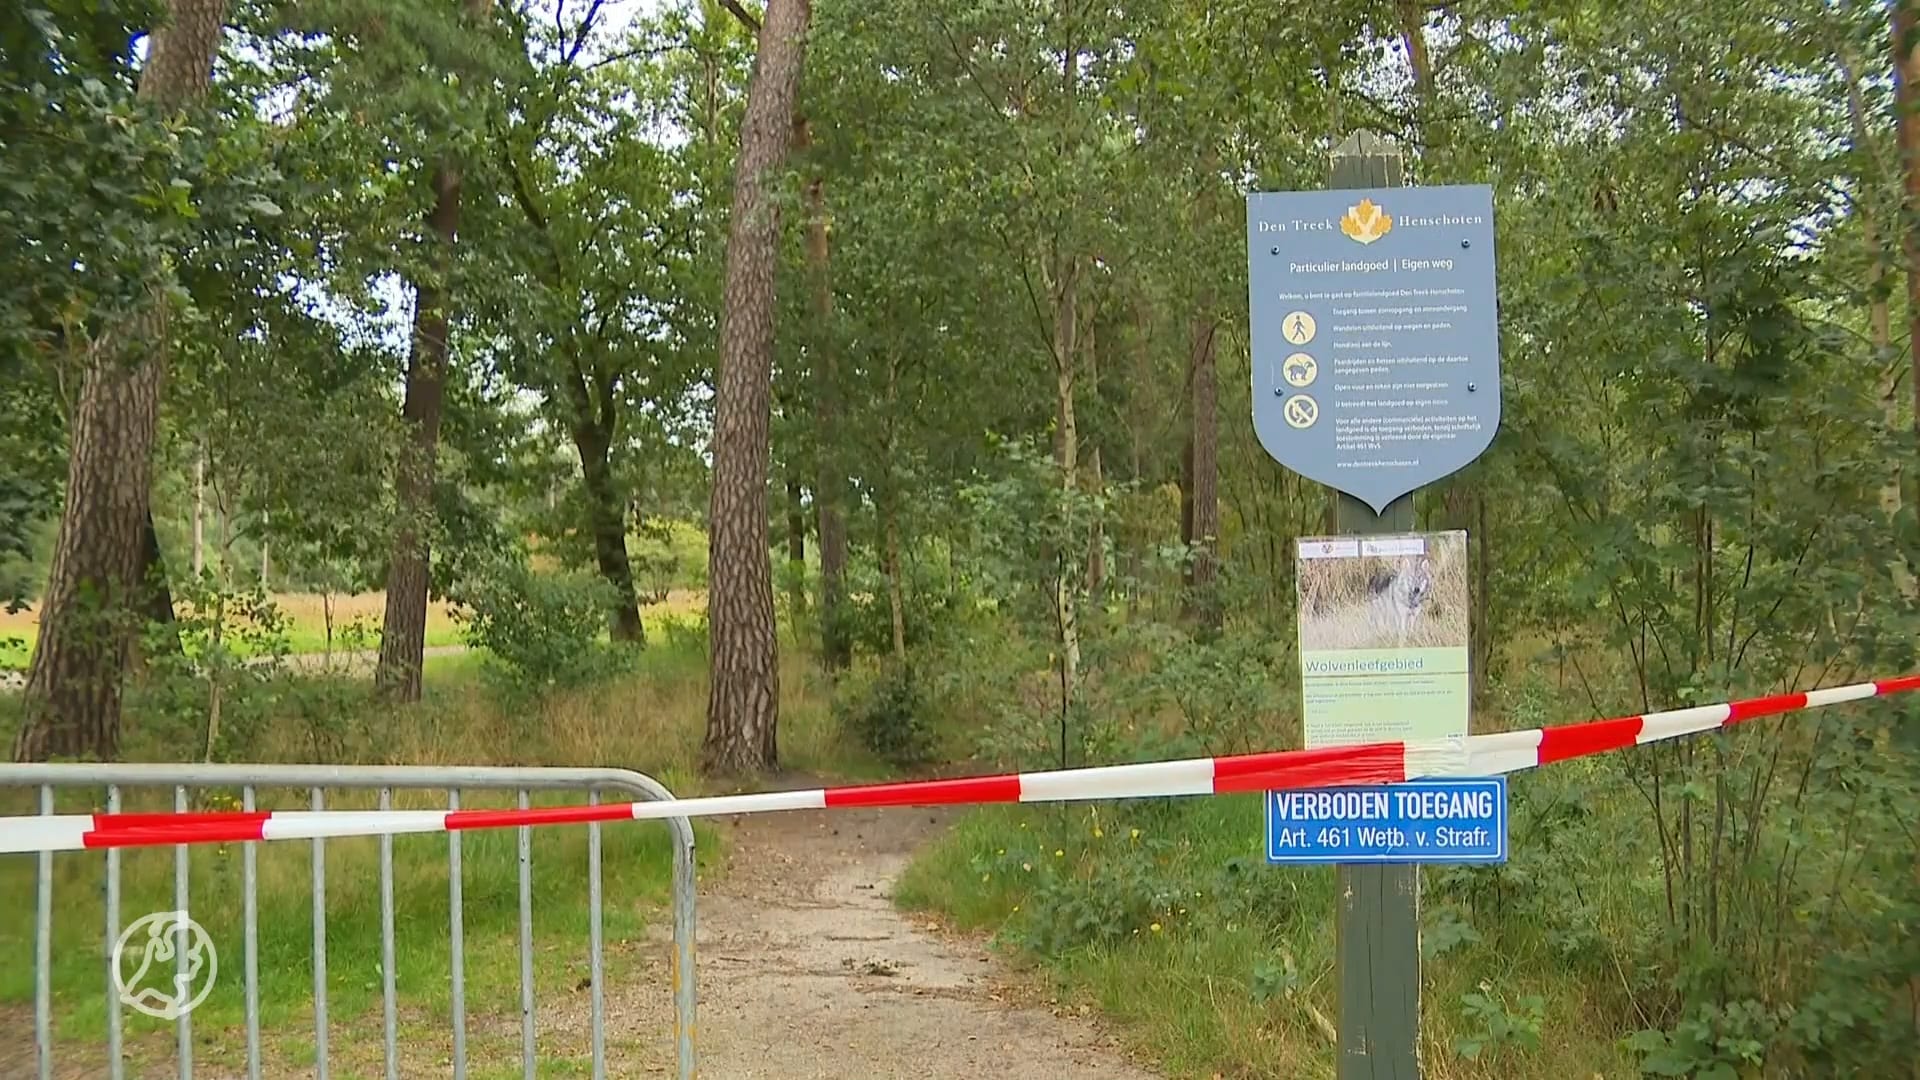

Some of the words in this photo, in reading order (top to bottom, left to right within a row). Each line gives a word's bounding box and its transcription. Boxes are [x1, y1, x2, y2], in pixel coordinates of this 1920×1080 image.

[1259, 221, 1286, 232] Den
[1292, 219, 1333, 231] Treek
[1399, 214, 1482, 227] Henschoten
[1290, 261, 1339, 273] Particulier
[1341, 258, 1389, 272] landgoed
[1402, 258, 1429, 271] Eigen
[1431, 260, 1453, 271] weg
[1333, 308, 1358, 316] Toegang
[1334, 358, 1366, 366] Paardrijden
[1334, 384, 1350, 392] Open
[1378, 400, 1405, 408] landgoed
[1336, 426, 1364, 434] landgoed
[1452, 423, 1481, 432] schriftelijk
[1336, 434, 1374, 442] toestemming
[1305, 657, 1423, 672] Wolvenleefgebied
[1276, 792, 1389, 820] VERBODEN
[1394, 791, 1492, 819] TOEGANG
[1279, 828, 1311, 848] Art.
[1317, 828, 1350, 847] 461
[1357, 826, 1409, 847] Wetb.
[1415, 831, 1430, 847] v.
[1436, 826, 1490, 847] Strafr.
